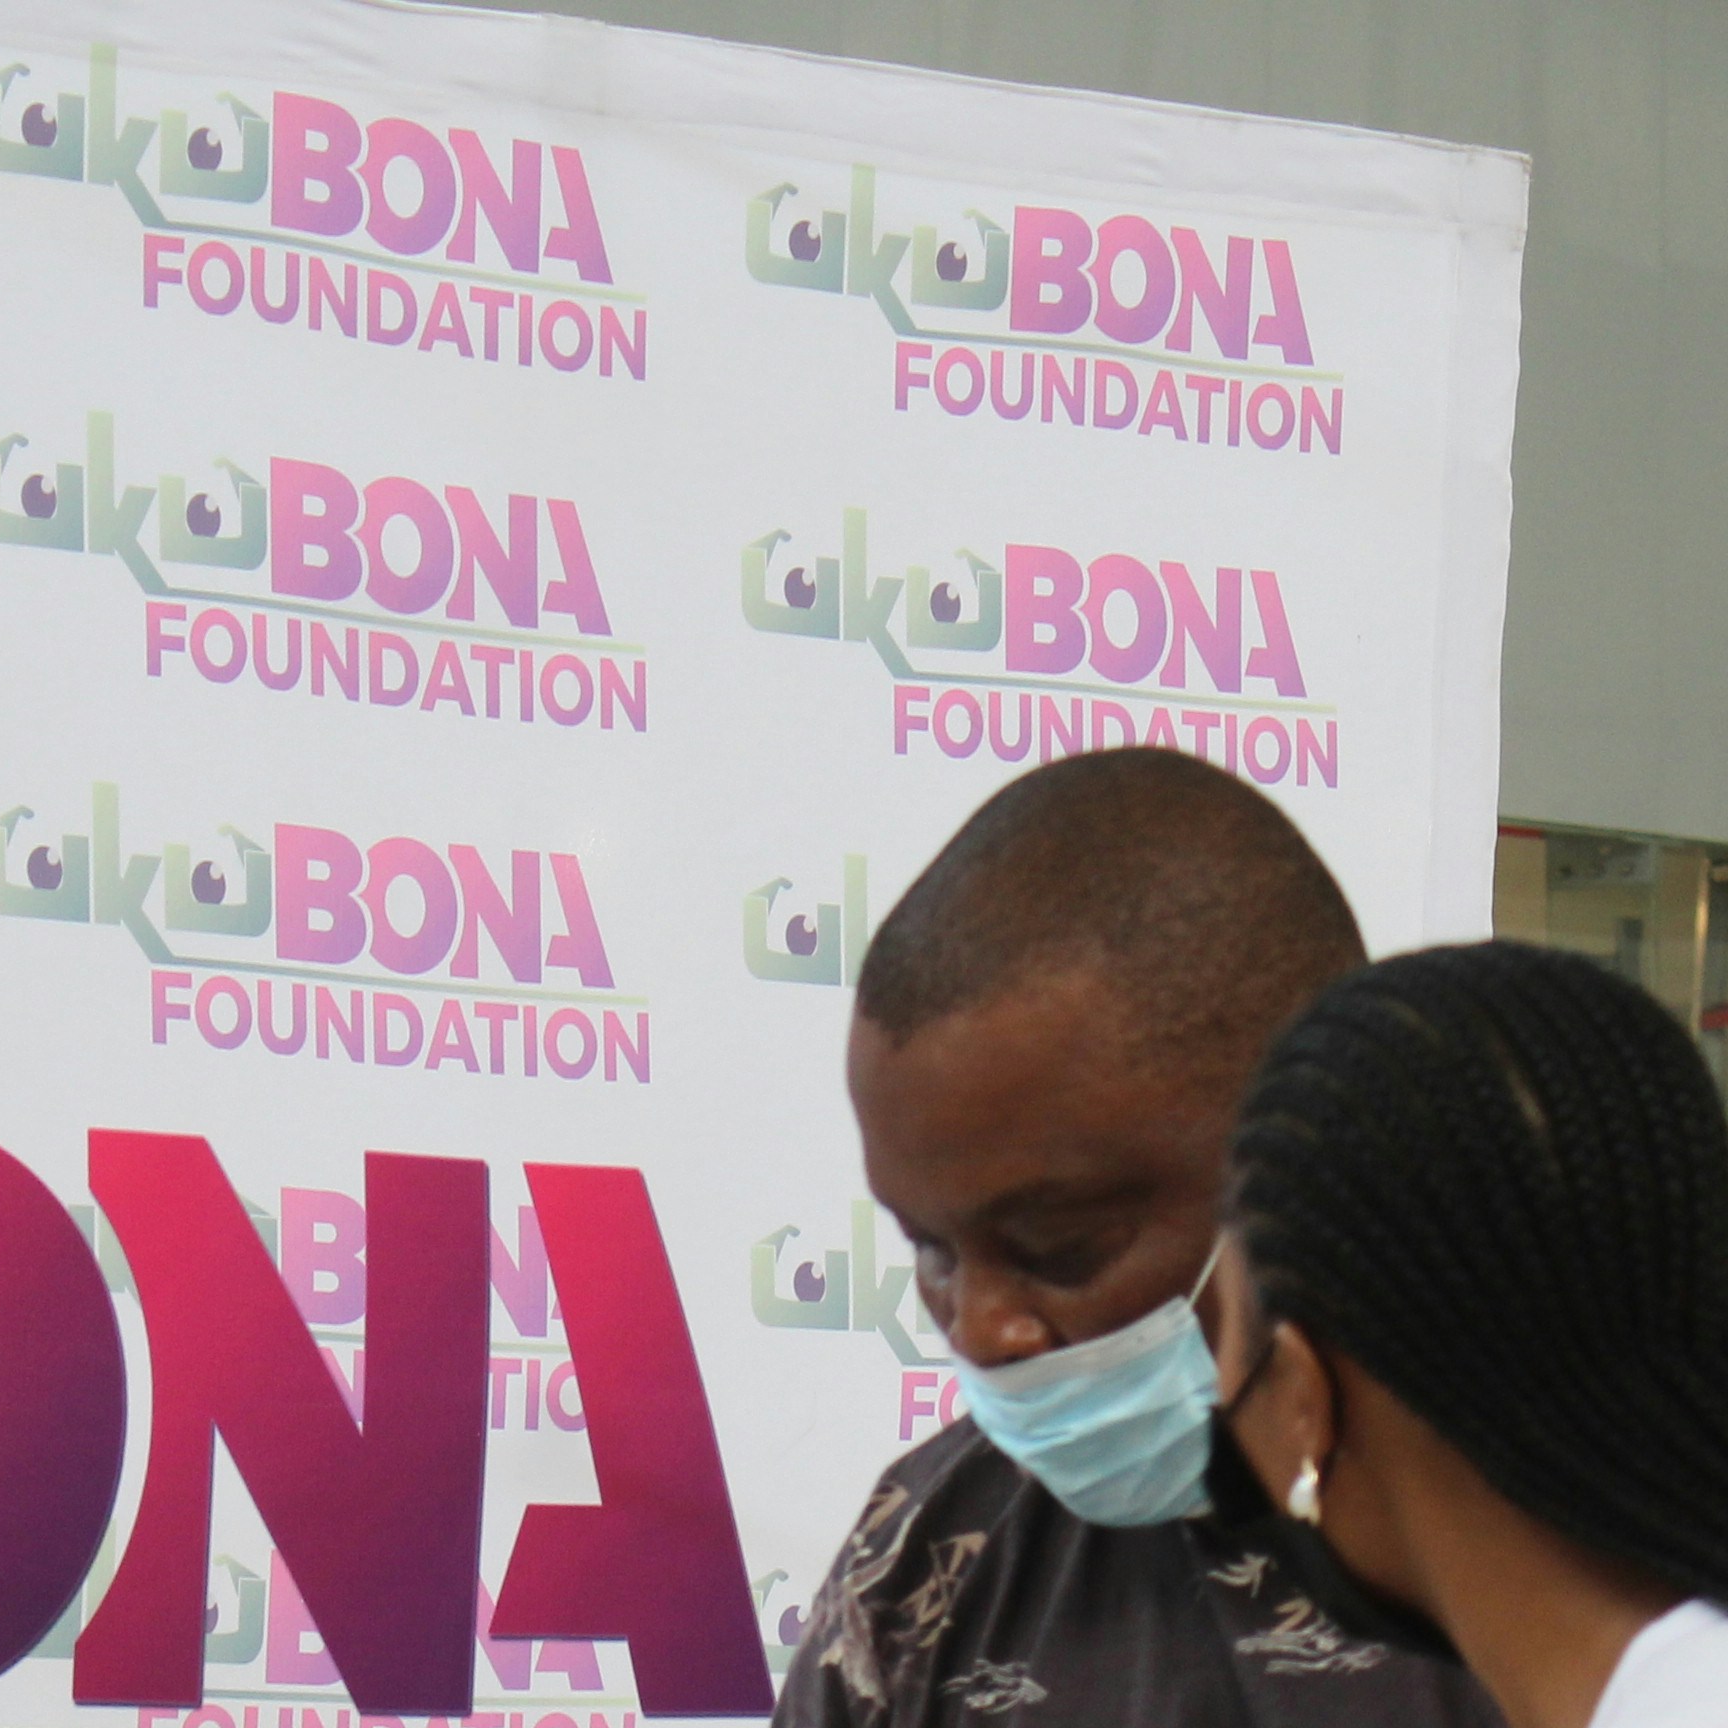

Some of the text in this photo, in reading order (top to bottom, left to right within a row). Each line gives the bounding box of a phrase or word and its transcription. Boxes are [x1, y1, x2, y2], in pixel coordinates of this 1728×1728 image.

[143, 233, 647, 381] FOUNDATION
[894, 341, 1344, 455] FOUNDATION
[145, 601, 648, 732] FOUNDATION
[151, 969, 651, 1084] FOUNDATION
